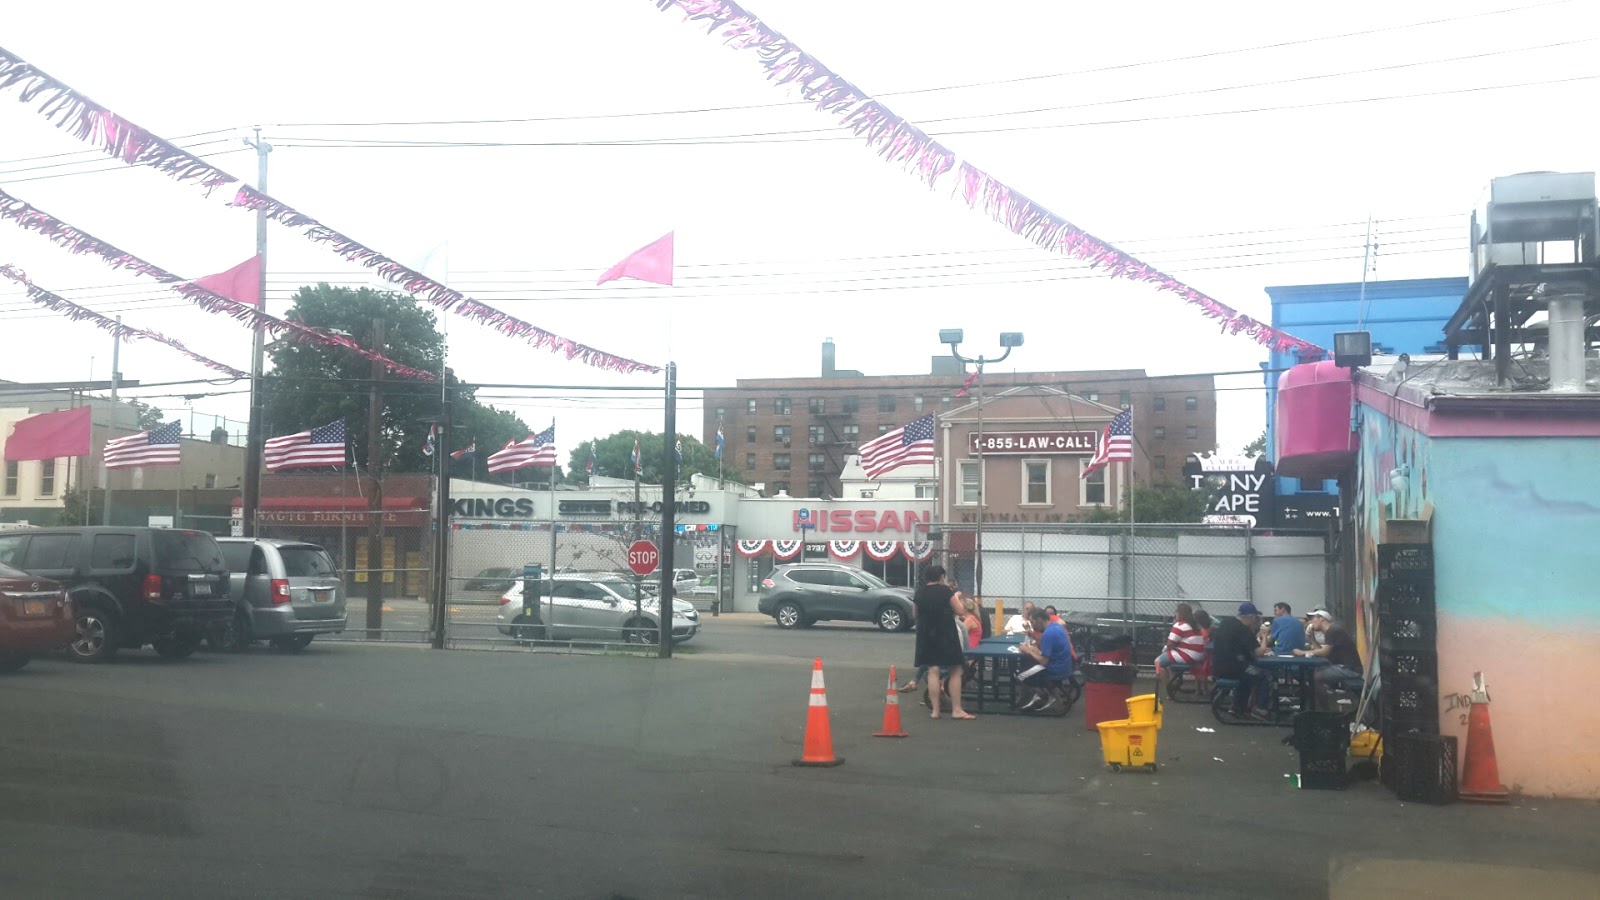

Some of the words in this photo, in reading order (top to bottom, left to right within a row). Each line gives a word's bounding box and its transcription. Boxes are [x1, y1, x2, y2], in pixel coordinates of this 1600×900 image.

[974, 437, 1092, 449] 1-855-LAW-CALL
[1230, 474, 1266, 492] NY
[448, 498, 534, 517] KINGS
[1204, 494, 1260, 512] APE
[313, 511, 396, 521] FURNITE
[793, 509, 930, 532] NISSAN
[629, 551, 657, 564] STOP
